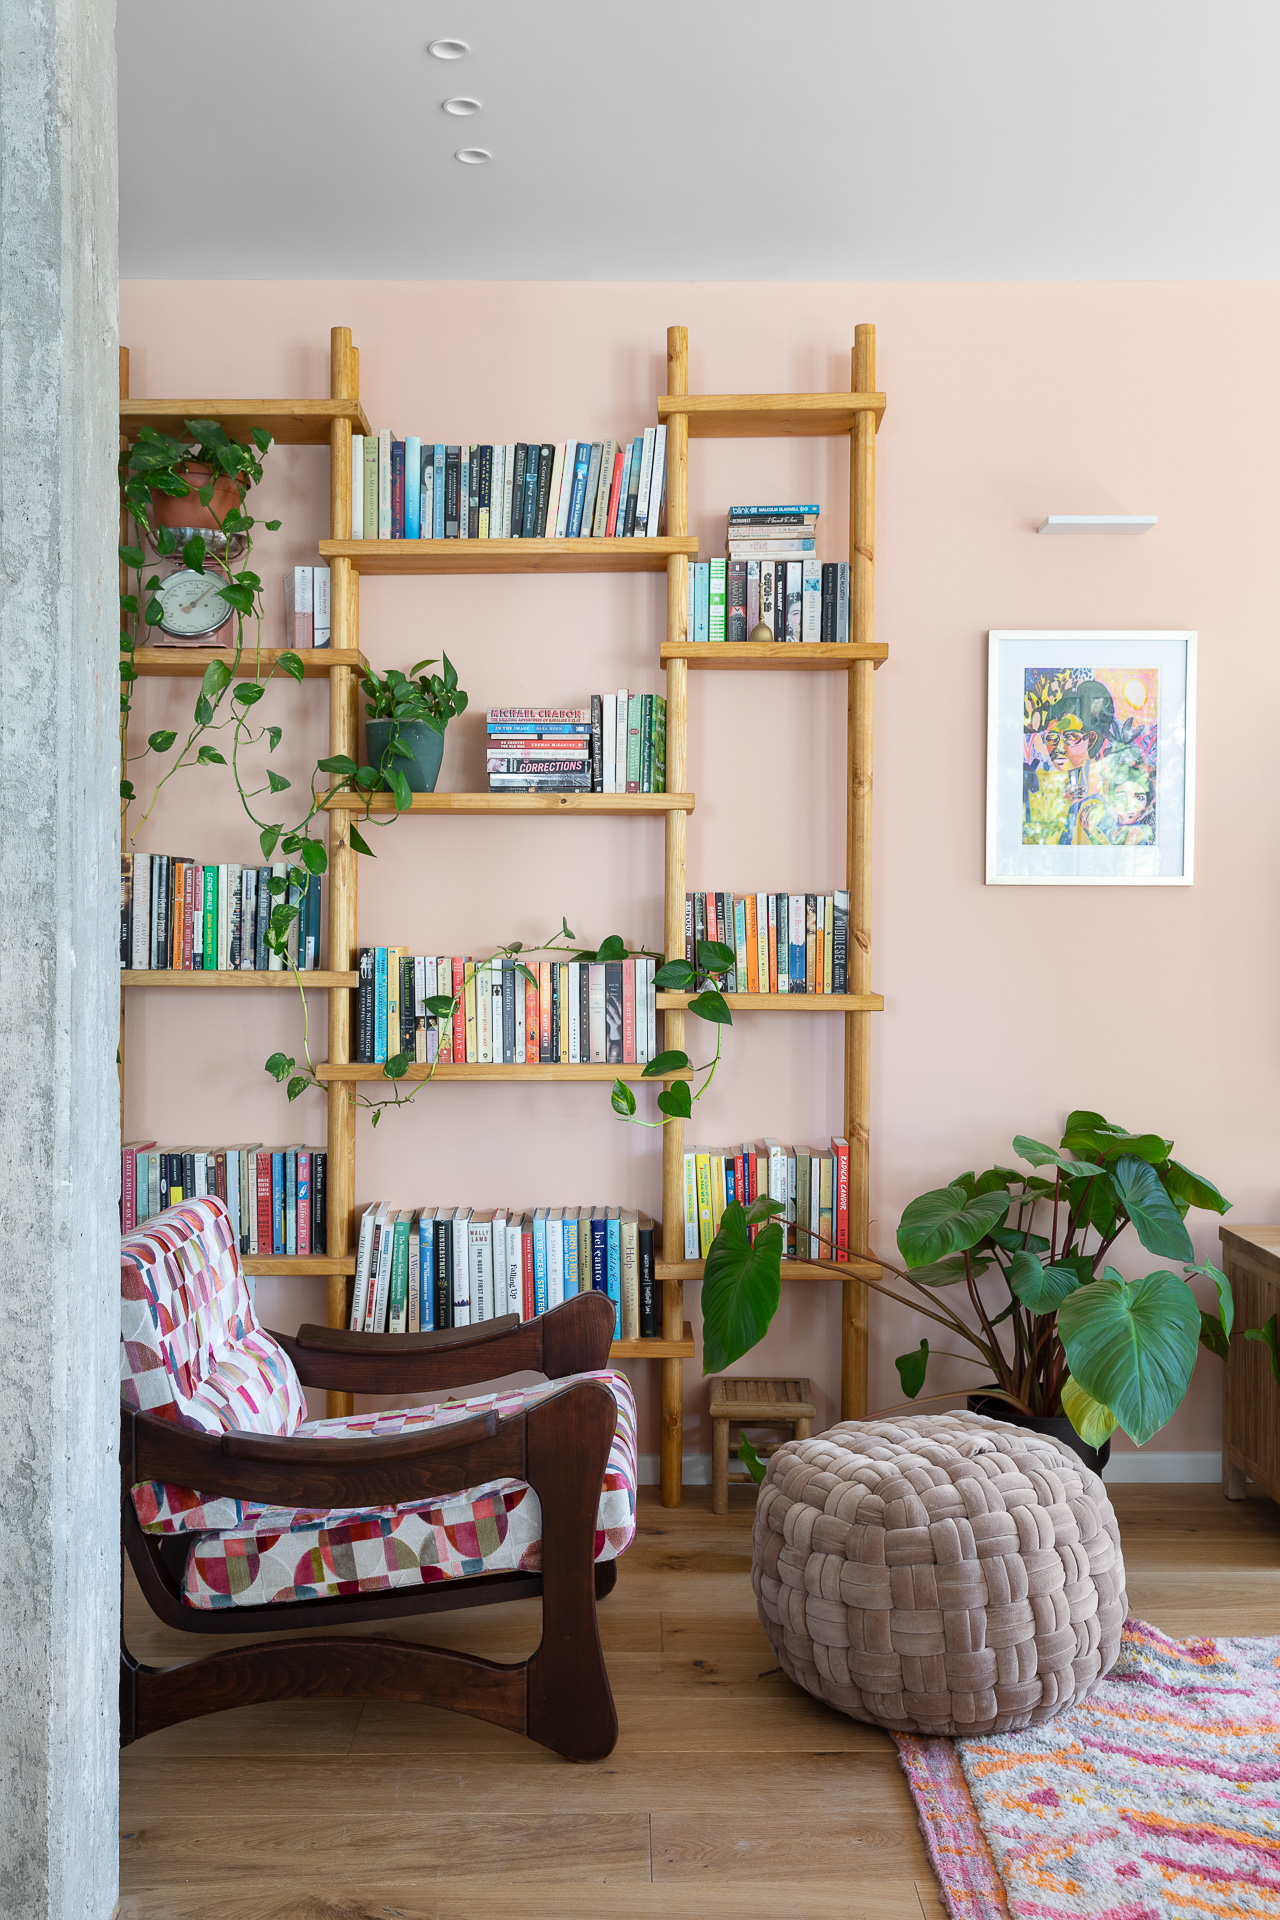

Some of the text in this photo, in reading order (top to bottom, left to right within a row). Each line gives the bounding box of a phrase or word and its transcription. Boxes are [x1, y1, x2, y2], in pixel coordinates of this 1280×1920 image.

[572, 511, 580, 532] Laughter
[539, 710, 581, 718] CHABON
[519, 761, 582, 772] CORRECTIONS
[136, 862, 141, 873] OF
[142, 865, 147, 874] TO
[835, 920, 845, 964] MIDDLESEX
[126, 1208, 131, 1218] ON
[300, 1229, 306, 1237] Pi
[569, 1225, 577, 1250] BORN
[569, 1250, 577, 1262] TO
[594, 1231, 604, 1281] bel canto
[609, 1241, 618, 1264] World
[624, 1247, 635, 1269] Help
[410, 1260, 418, 1284] Weave
[509, 1264, 518, 1288] Falling
[609, 1273, 618, 1292] Come
[510, 1289, 518, 1299] Up
[410, 1293, 418, 1321] Women
